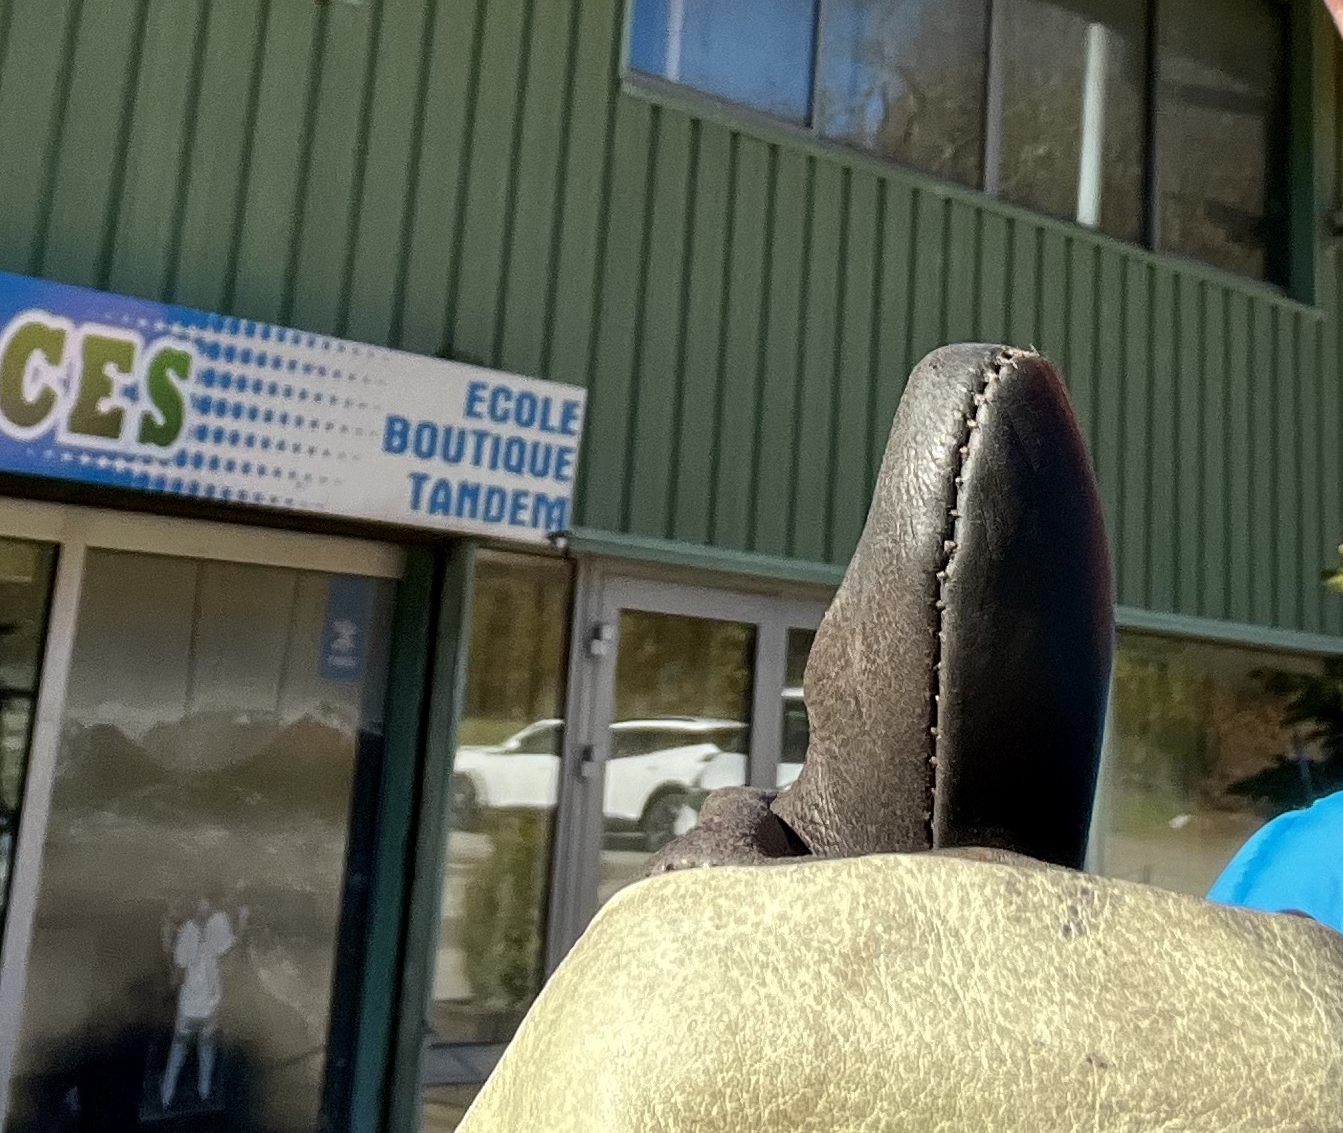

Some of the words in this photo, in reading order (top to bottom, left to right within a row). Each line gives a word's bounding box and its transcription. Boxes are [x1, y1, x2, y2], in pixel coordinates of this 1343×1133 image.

[464, 380, 581, 436] ECOLE
[382, 414, 577, 482] BOUTIQUE
[409, 471, 571, 531] TANDEM
